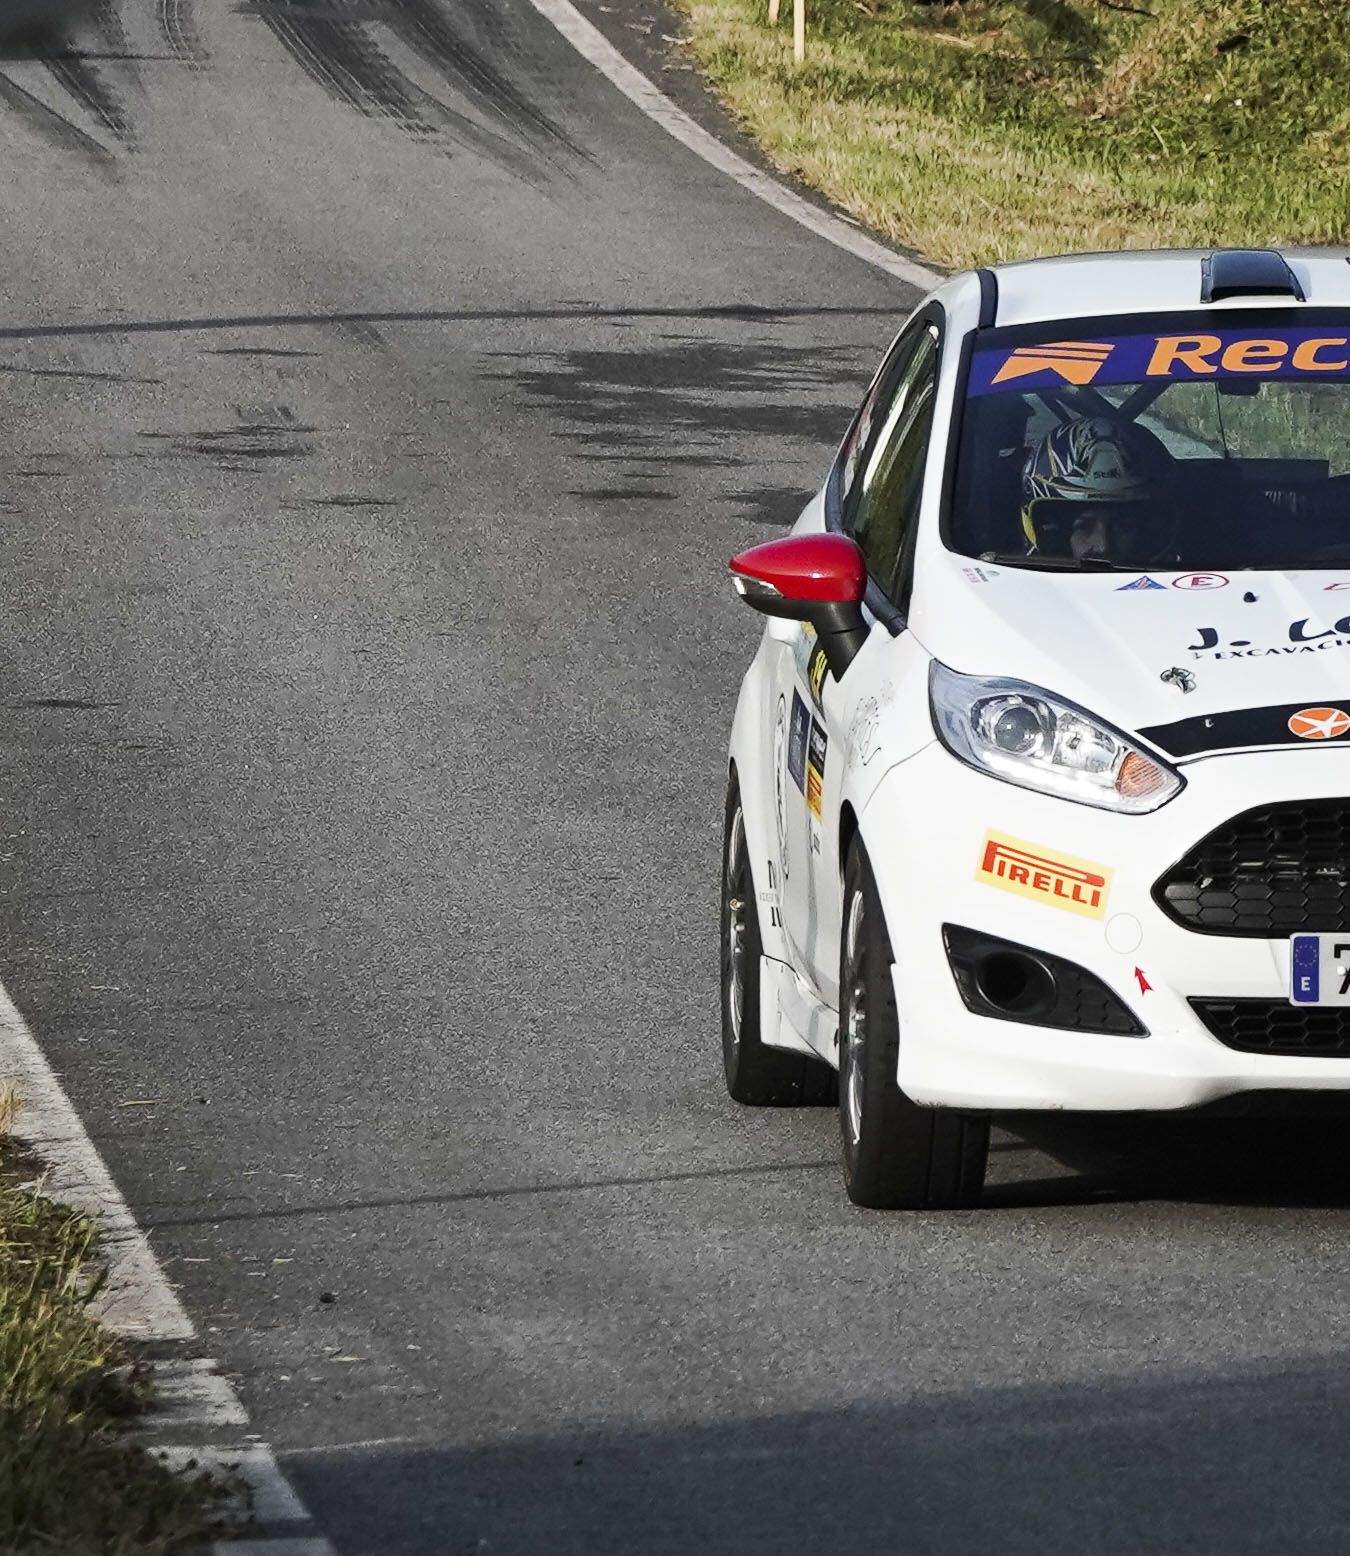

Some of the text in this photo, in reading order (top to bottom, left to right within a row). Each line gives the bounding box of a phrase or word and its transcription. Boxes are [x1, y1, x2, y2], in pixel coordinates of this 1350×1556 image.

[1188, 627, 1251, 649] J.
[981, 840, 1105, 907] PIRELLI
[1301, 976, 1311, 991] E
